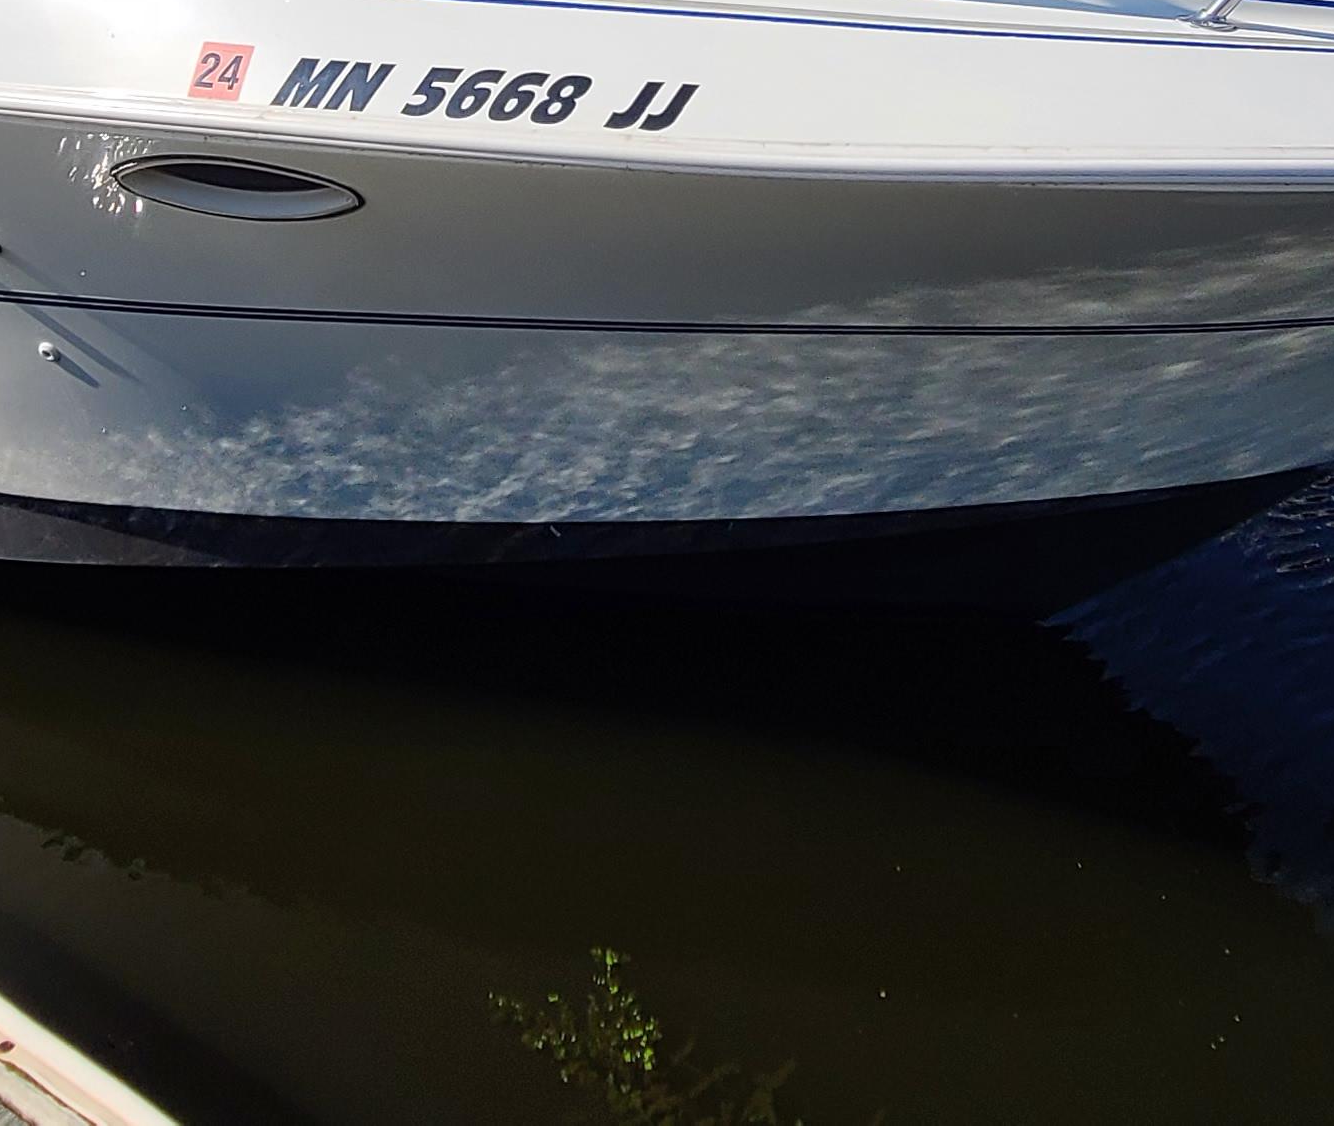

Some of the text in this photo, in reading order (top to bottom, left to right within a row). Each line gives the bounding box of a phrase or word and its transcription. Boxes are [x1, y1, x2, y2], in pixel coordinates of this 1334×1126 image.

[194, 52, 244, 91] 24
[269, 57, 700, 132] MN 5668 JJ
